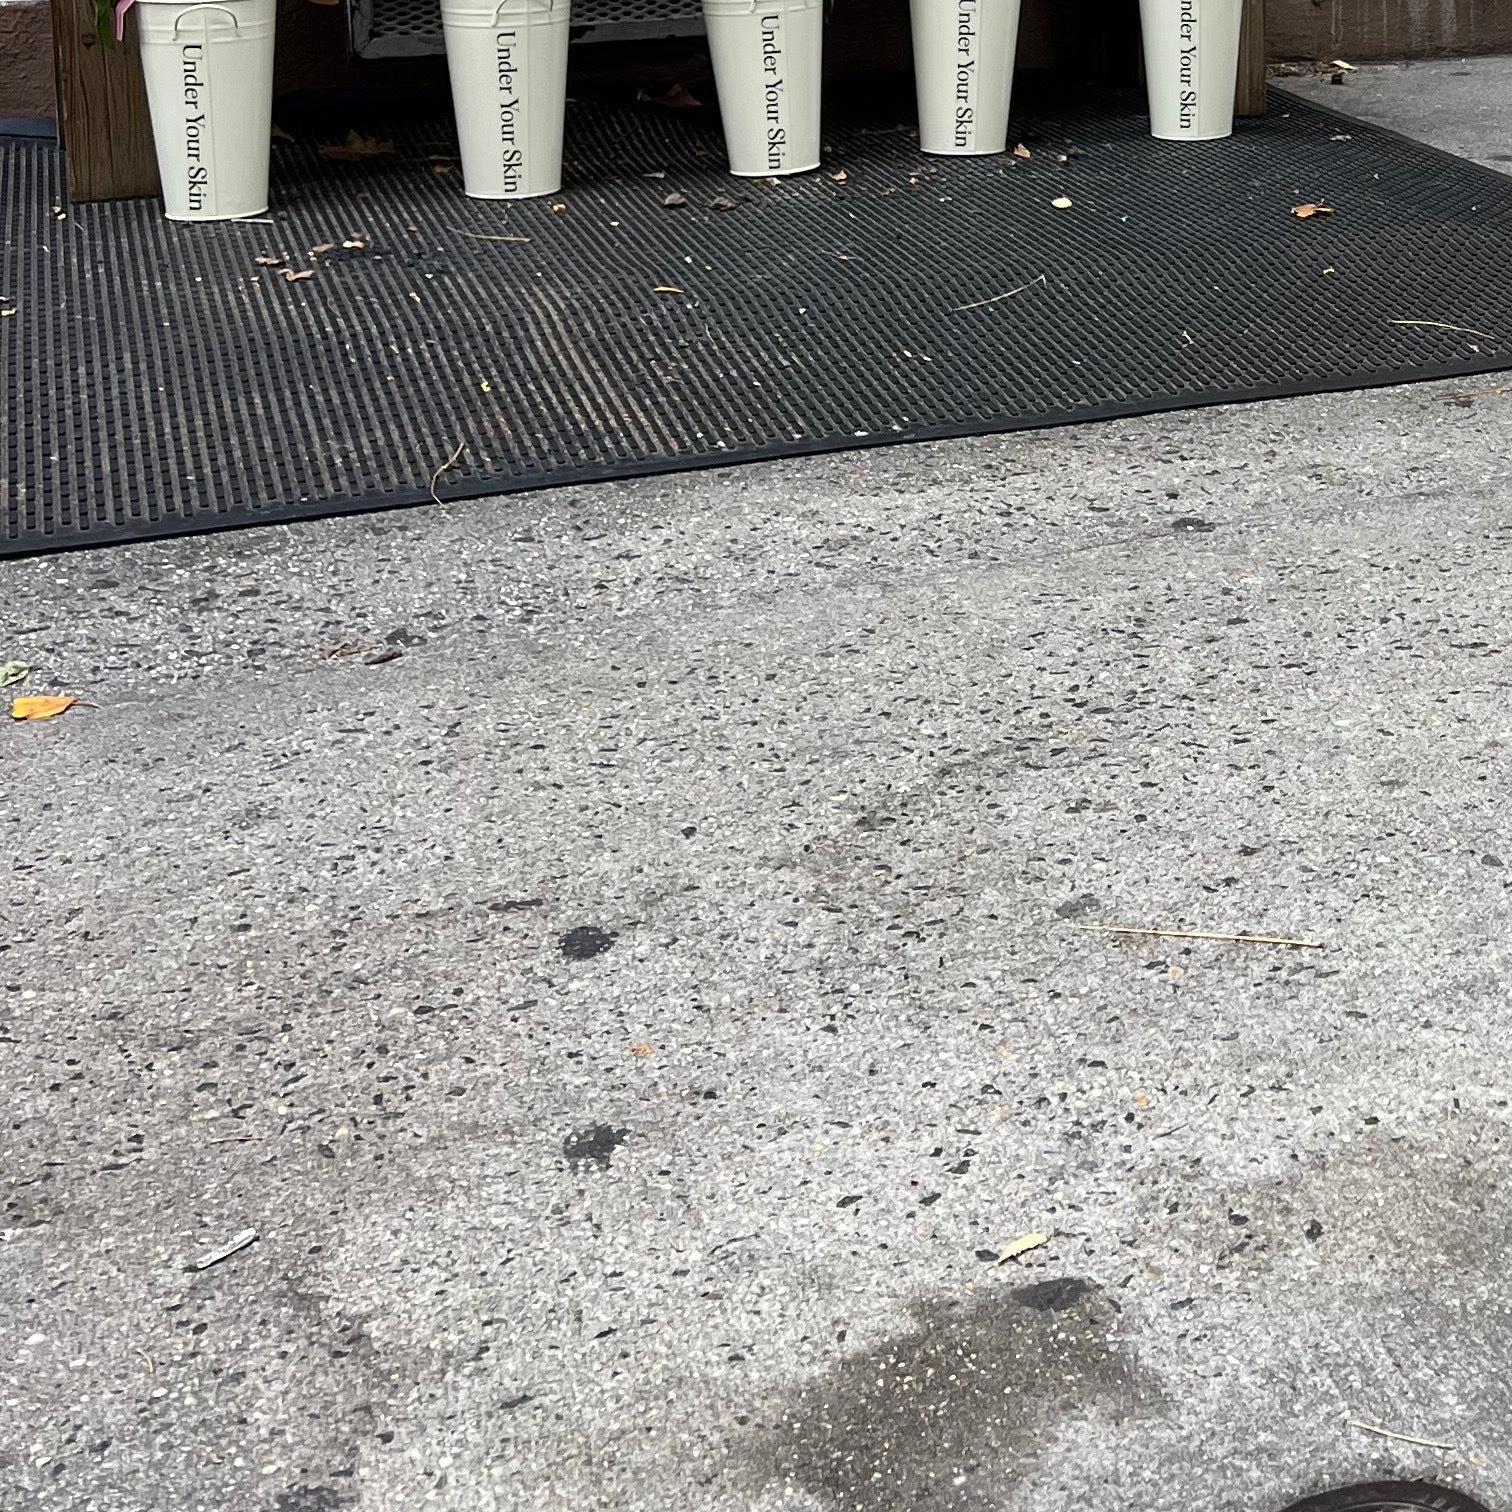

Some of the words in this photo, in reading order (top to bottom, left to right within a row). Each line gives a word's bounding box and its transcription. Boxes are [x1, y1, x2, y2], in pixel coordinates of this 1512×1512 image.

[496, 31, 518, 94] Under
[760, 15, 780, 77] Under
[1179, 46, 1198, 87] Your
[182, 44, 204, 110] Under
[956, 59, 976, 105] Your
[499, 96, 520, 146] Your
[764, 79, 786, 126] Your
[1178, 90, 1197, 130] Skin
[185, 113, 206, 163] Your
[767, 128, 788, 170] Skin
[955, 107, 975, 148] Skin
[188, 166, 209, 211] Skin
[502, 149, 523, 193] Skin
